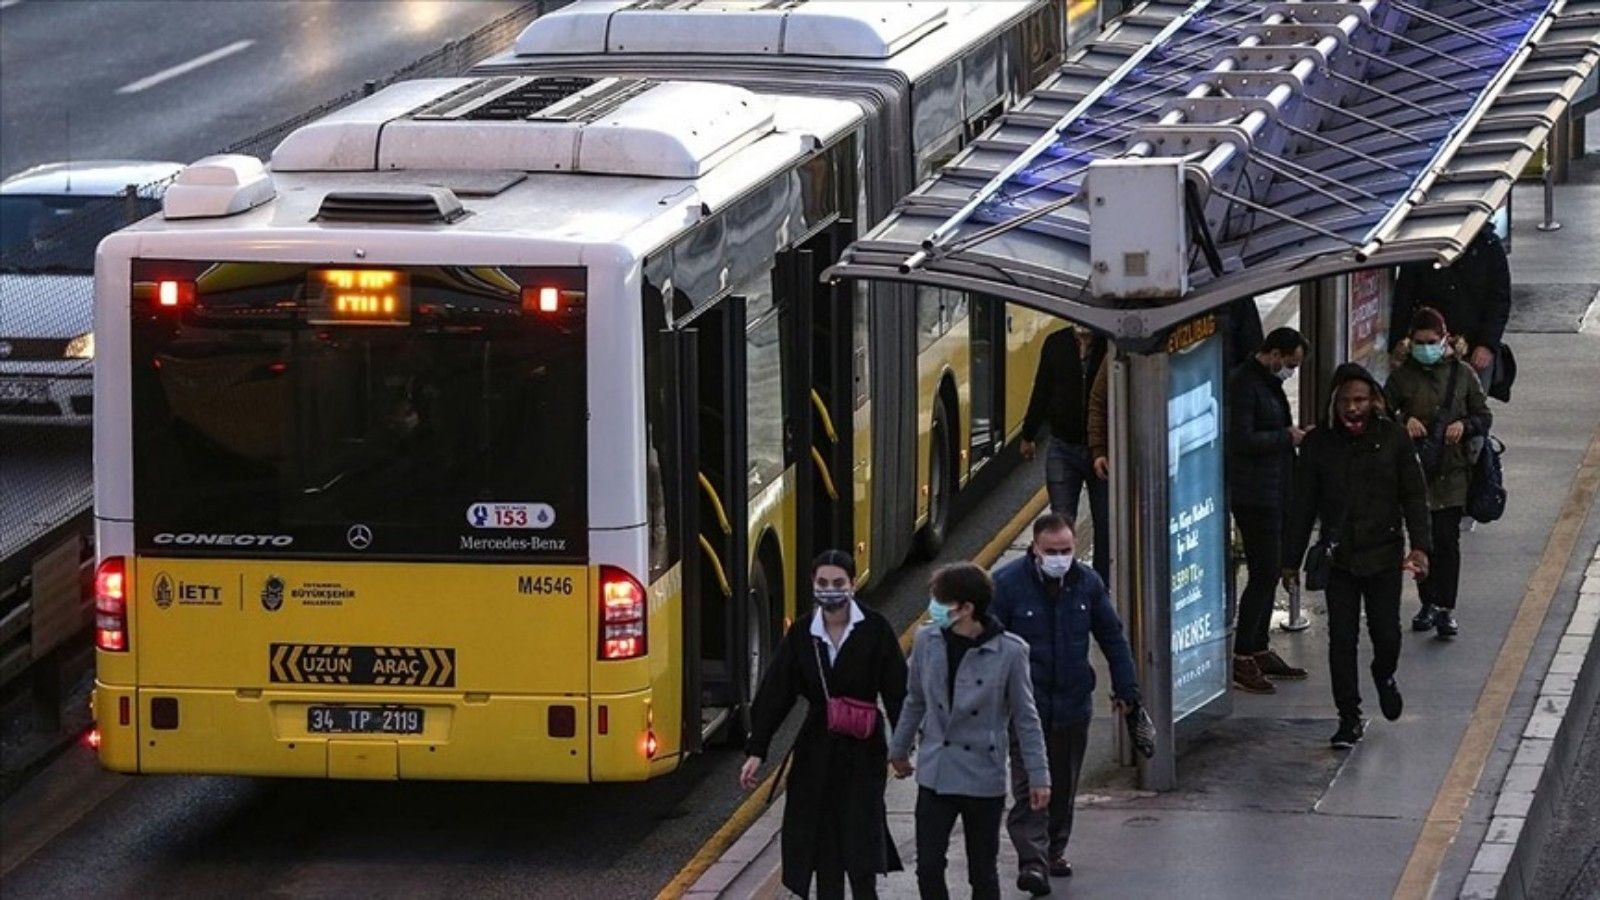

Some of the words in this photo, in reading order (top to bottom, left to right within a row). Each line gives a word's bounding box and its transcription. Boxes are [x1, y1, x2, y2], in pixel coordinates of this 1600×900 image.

[494, 510, 528, 526] 153
[153, 533, 293, 546] CONECTO
[460, 535, 566, 550] Mercedes-Benz
[179, 581, 222, 600] İETT
[518, 576, 573, 595] M4546
[302, 656, 352, 673] UZUN
[372, 658, 420, 677] ARAÇ
[312, 709, 334, 729] 34
[349, 710, 370, 729] TP
[383, 711, 418, 731] 2119
